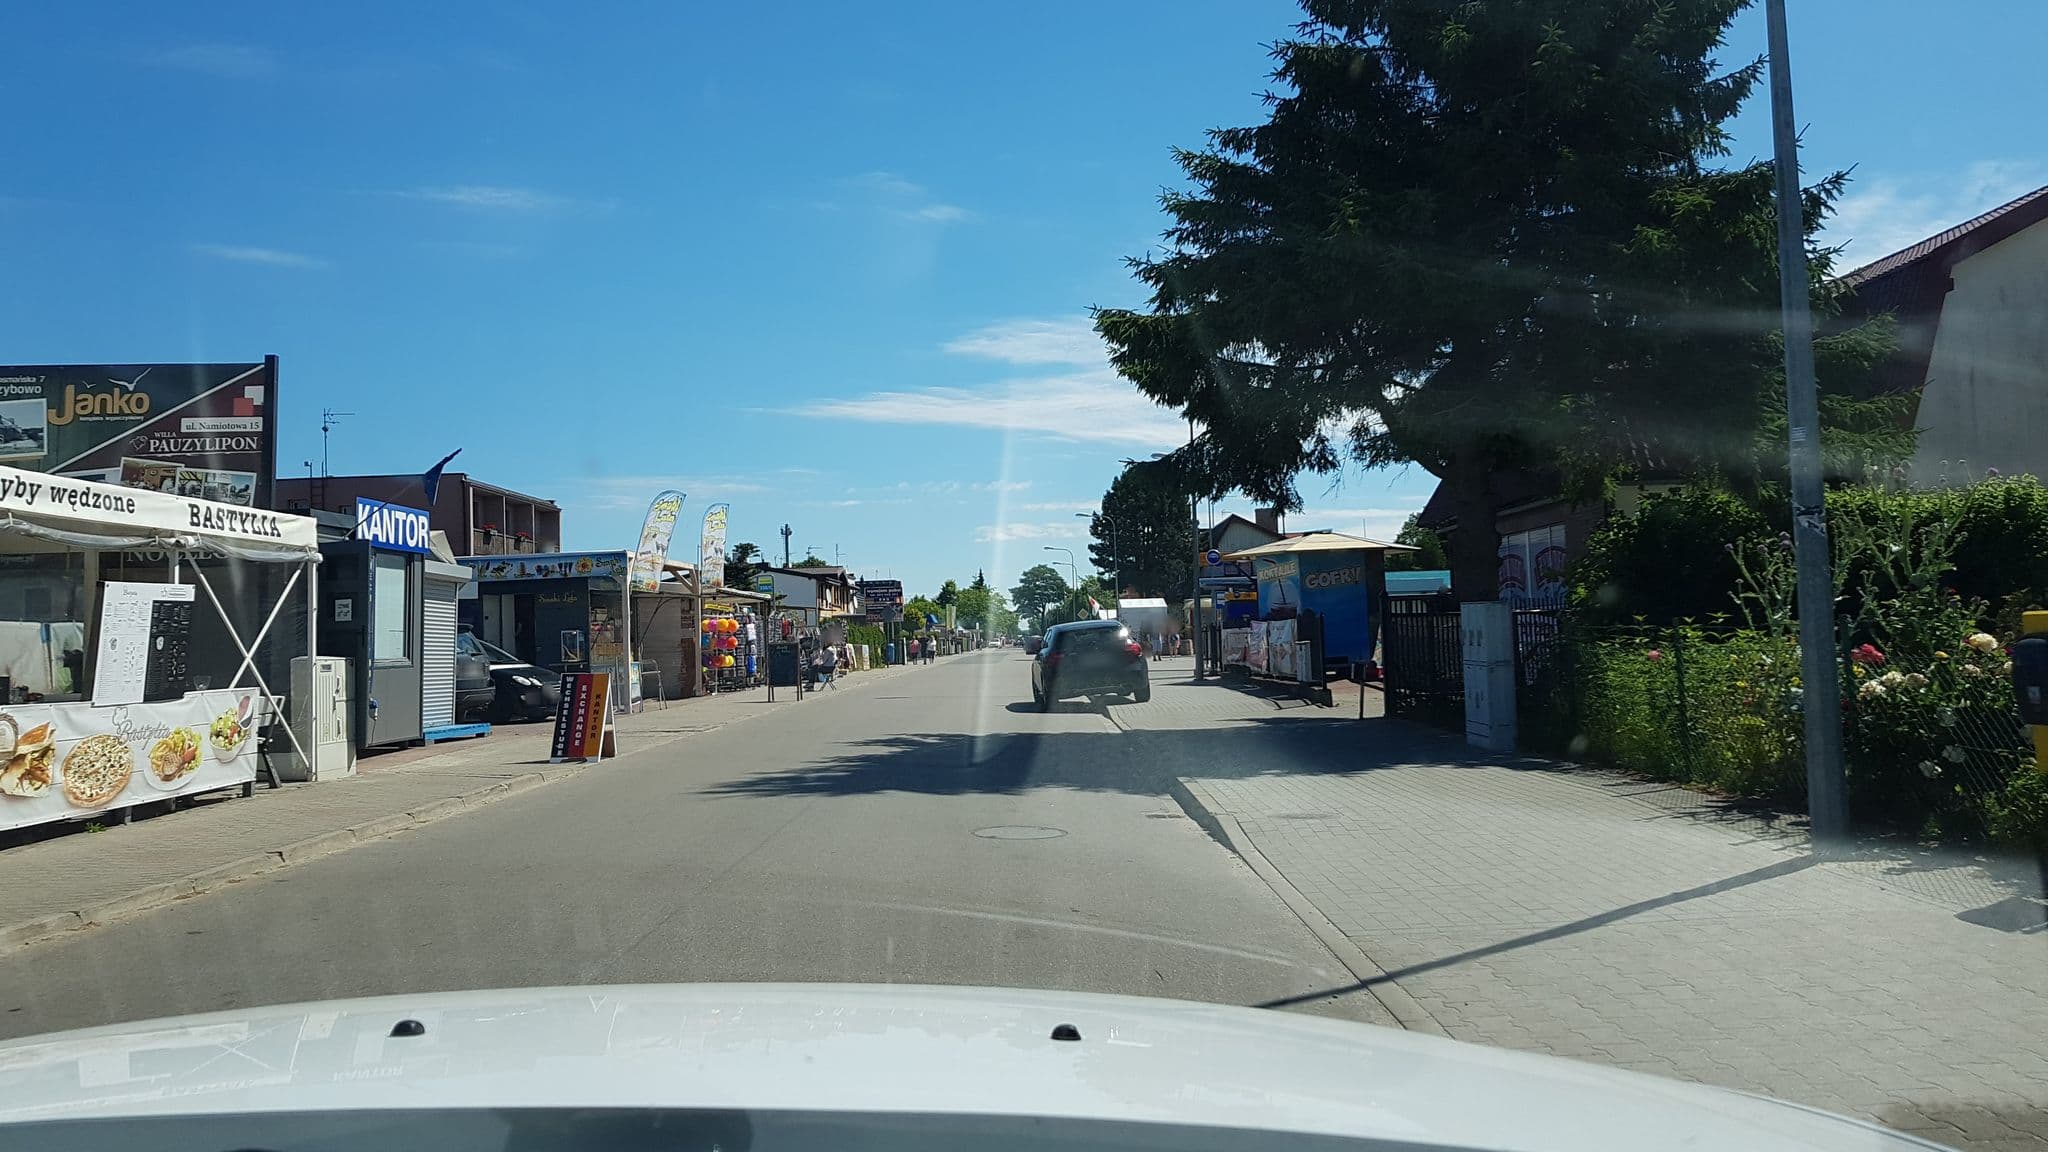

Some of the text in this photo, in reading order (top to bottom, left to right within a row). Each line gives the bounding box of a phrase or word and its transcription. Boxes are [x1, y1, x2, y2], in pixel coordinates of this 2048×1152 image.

[48, 384, 150, 425] Janko
[199, 421, 247, 430] Namiotowa
[250, 421, 260, 430] 15
[149, 437, 258, 452] PAUZYLIPON
[50, 486, 136, 513] wędzone
[188, 503, 282, 537] BASTYLIA
[358, 503, 429, 549] KANTOR
[574, 684, 588, 746] EXCHANGE
[590, 693, 602, 739] KANTOR
